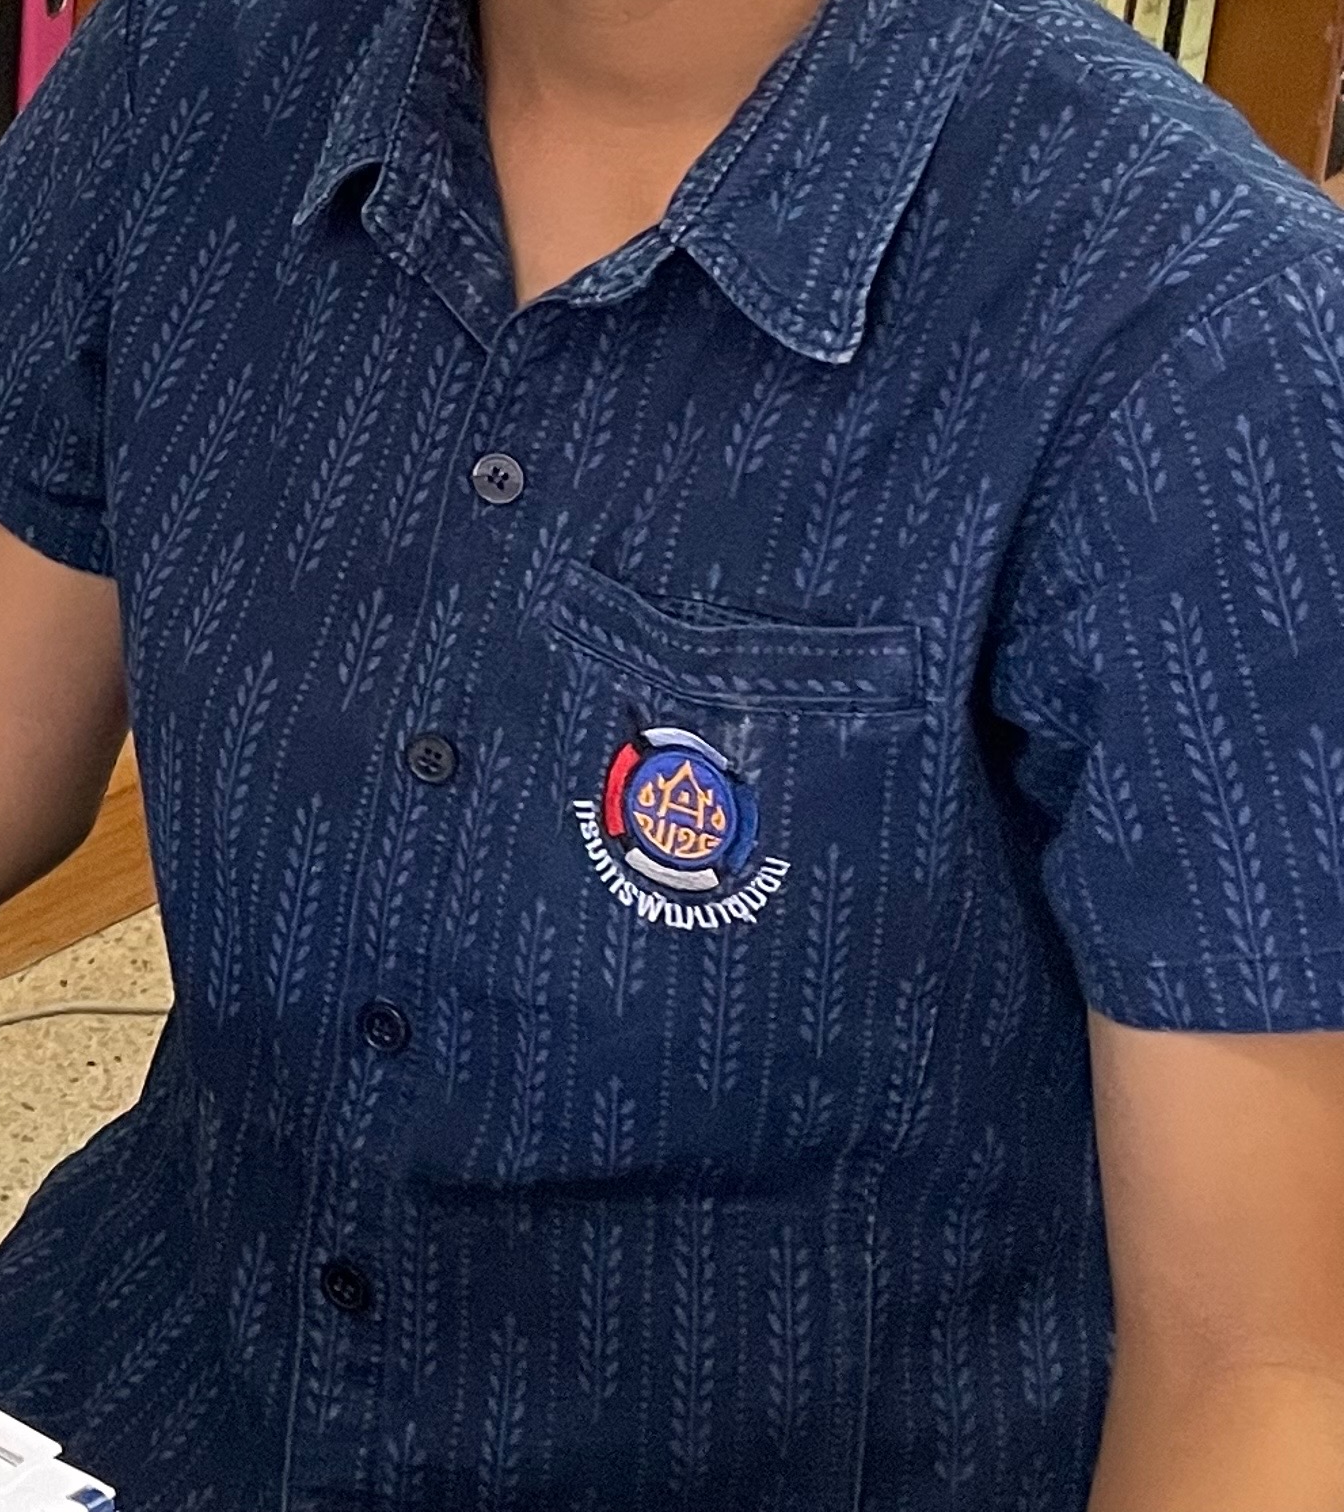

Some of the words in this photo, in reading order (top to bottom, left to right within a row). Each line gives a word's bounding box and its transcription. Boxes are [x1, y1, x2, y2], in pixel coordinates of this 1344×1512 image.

[572, 799, 792, 931] กรมการพัฒนาชุมชน
